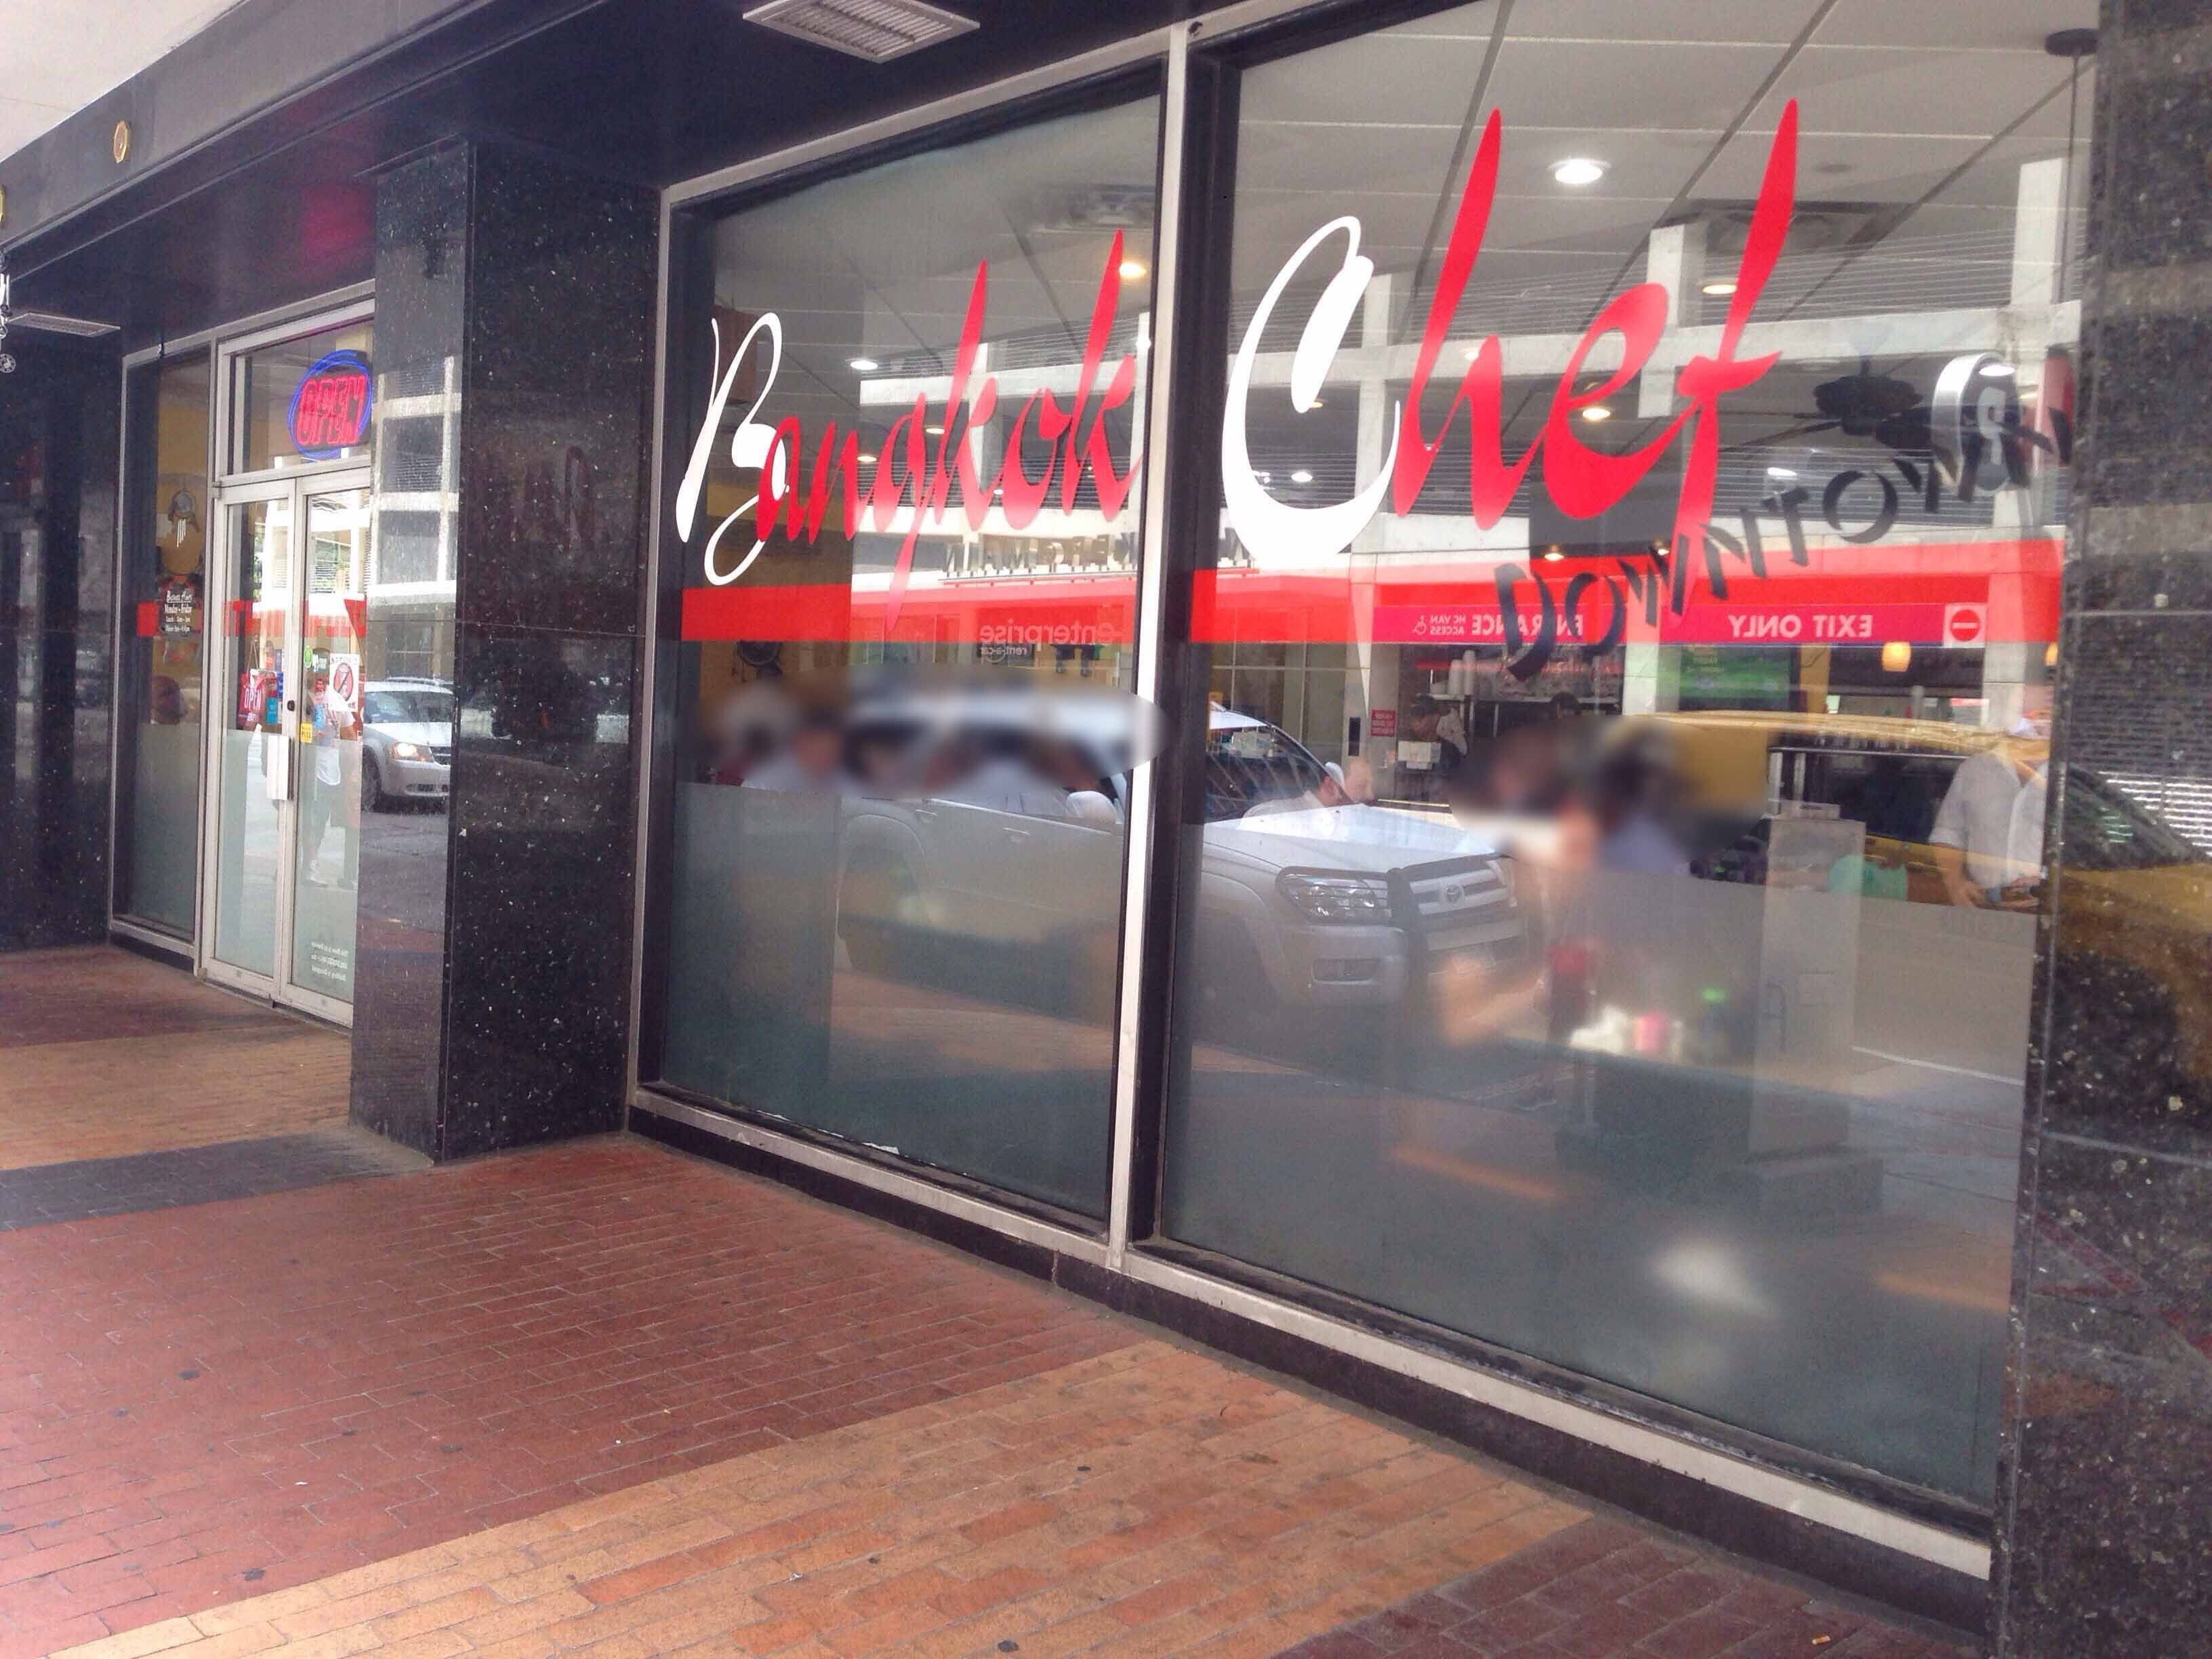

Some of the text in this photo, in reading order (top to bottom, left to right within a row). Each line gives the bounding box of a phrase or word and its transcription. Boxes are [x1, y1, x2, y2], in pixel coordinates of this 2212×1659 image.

[676, 98, 1798, 632] Bangkok Chef
[1494, 407, 2072, 680] DOWNTOWN
